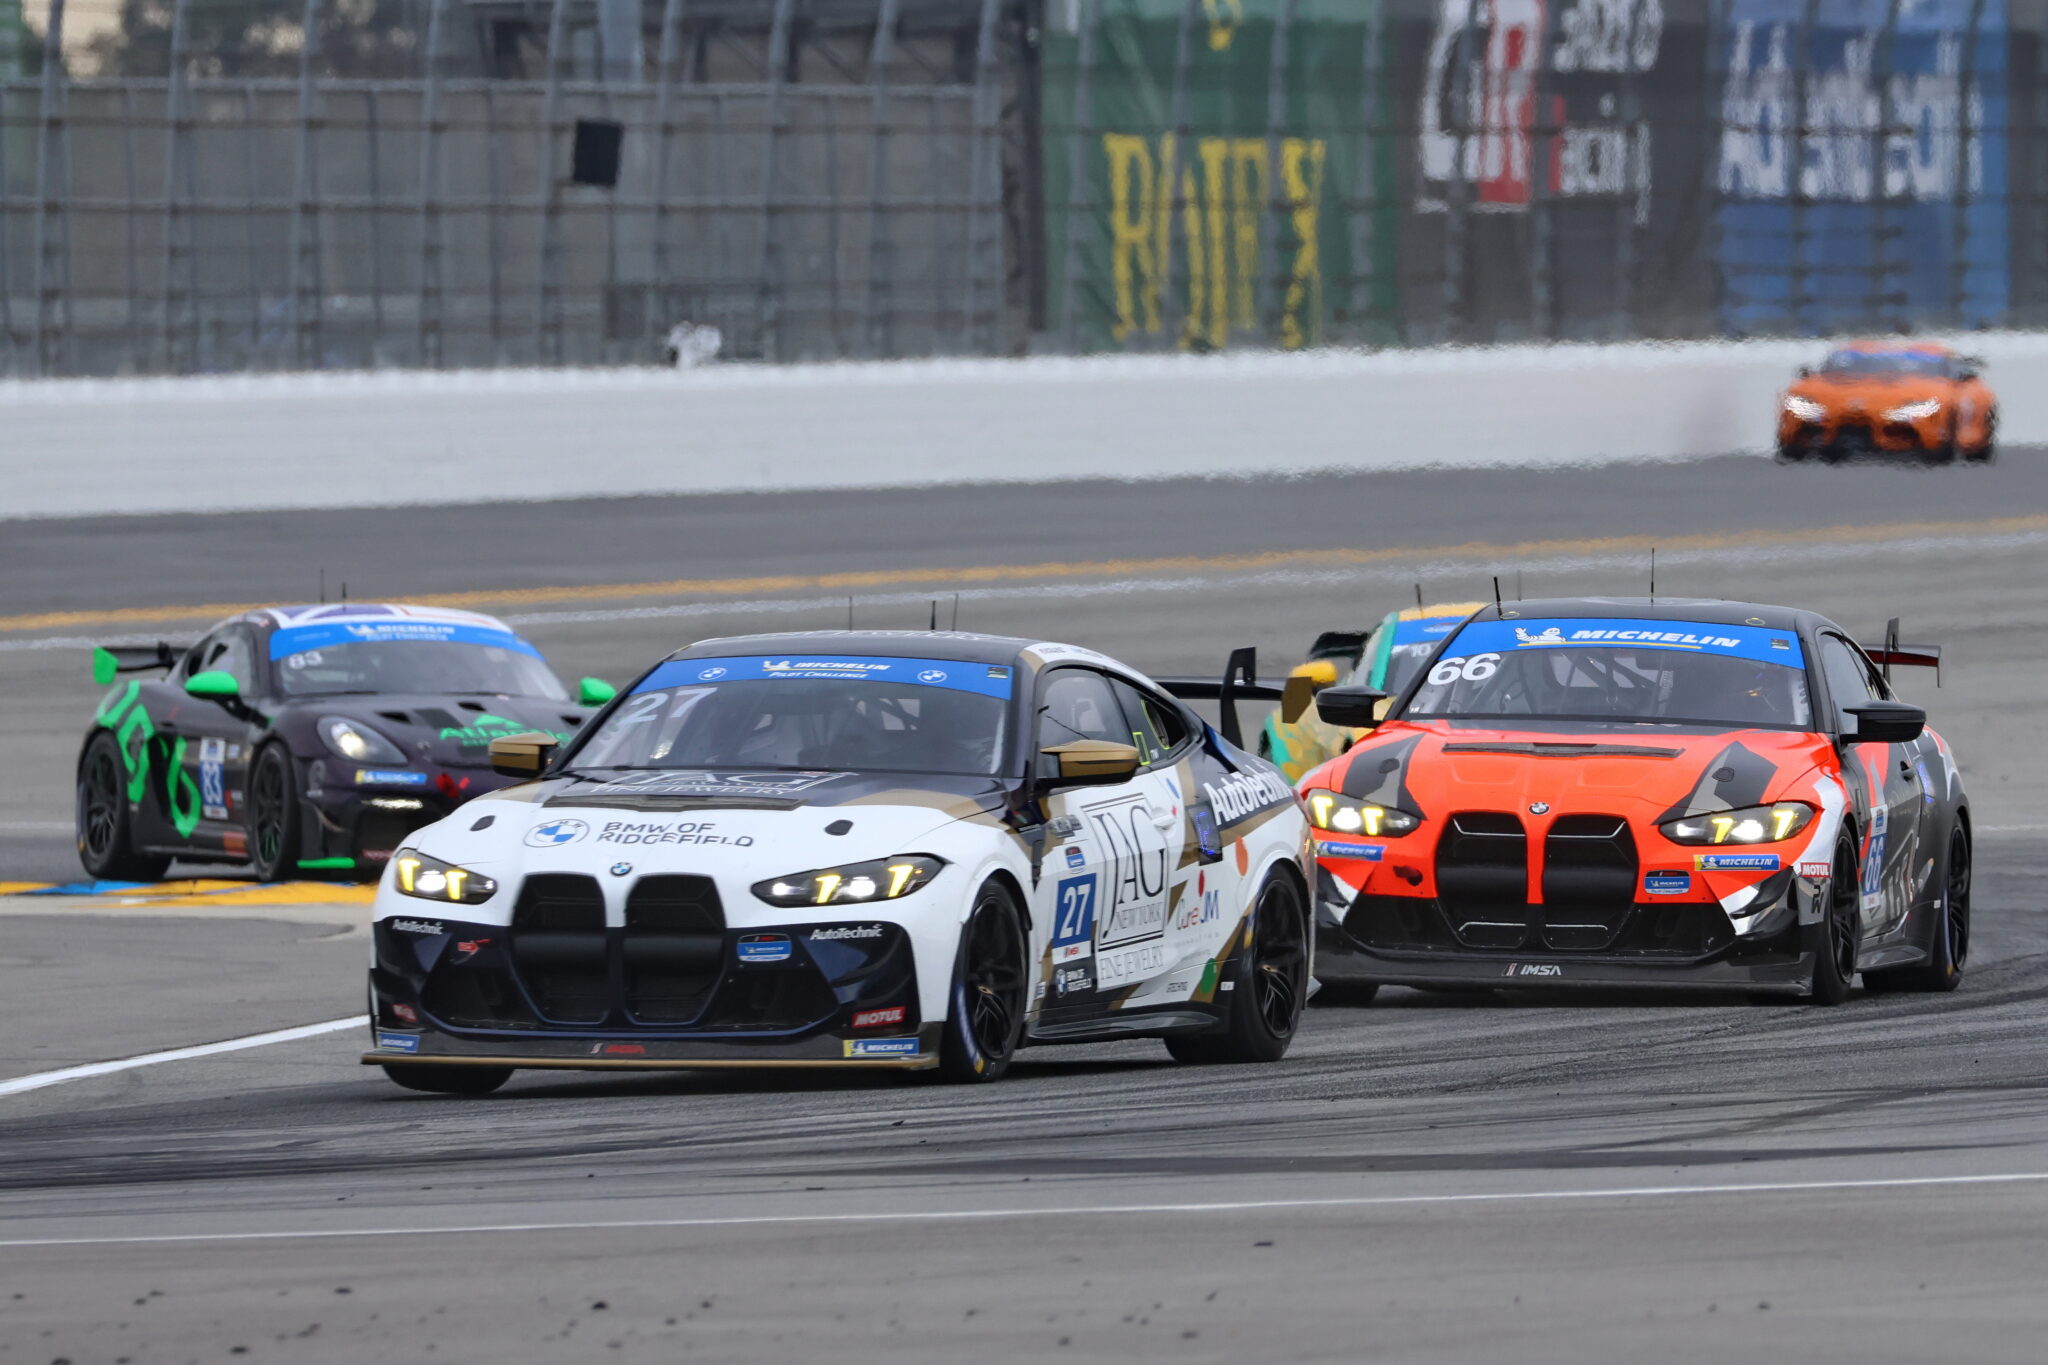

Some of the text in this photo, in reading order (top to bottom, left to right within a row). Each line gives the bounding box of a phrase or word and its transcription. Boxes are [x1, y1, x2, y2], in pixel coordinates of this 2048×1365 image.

[1571, 629, 1741, 648] MICHELIN
[288, 651, 323, 669] 83
[793, 662, 892, 671] MICHELIN
[1427, 652, 1501, 686] 66
[619, 687, 719, 725] 27
[603, 821, 717, 834] BMW OF
[1718, 857, 1774, 866] MICHELIN
[1802, 863, 1830, 876] MOTUL
[1865, 836, 1885, 893] 66
[1093, 804, 1165, 939] JAG
[1059, 884, 1091, 939] 27
[809, 924, 884, 941] AutoTechnic
[1520, 964, 1562, 976] IMSA
[854, 1009, 904, 1026] MOTUL
